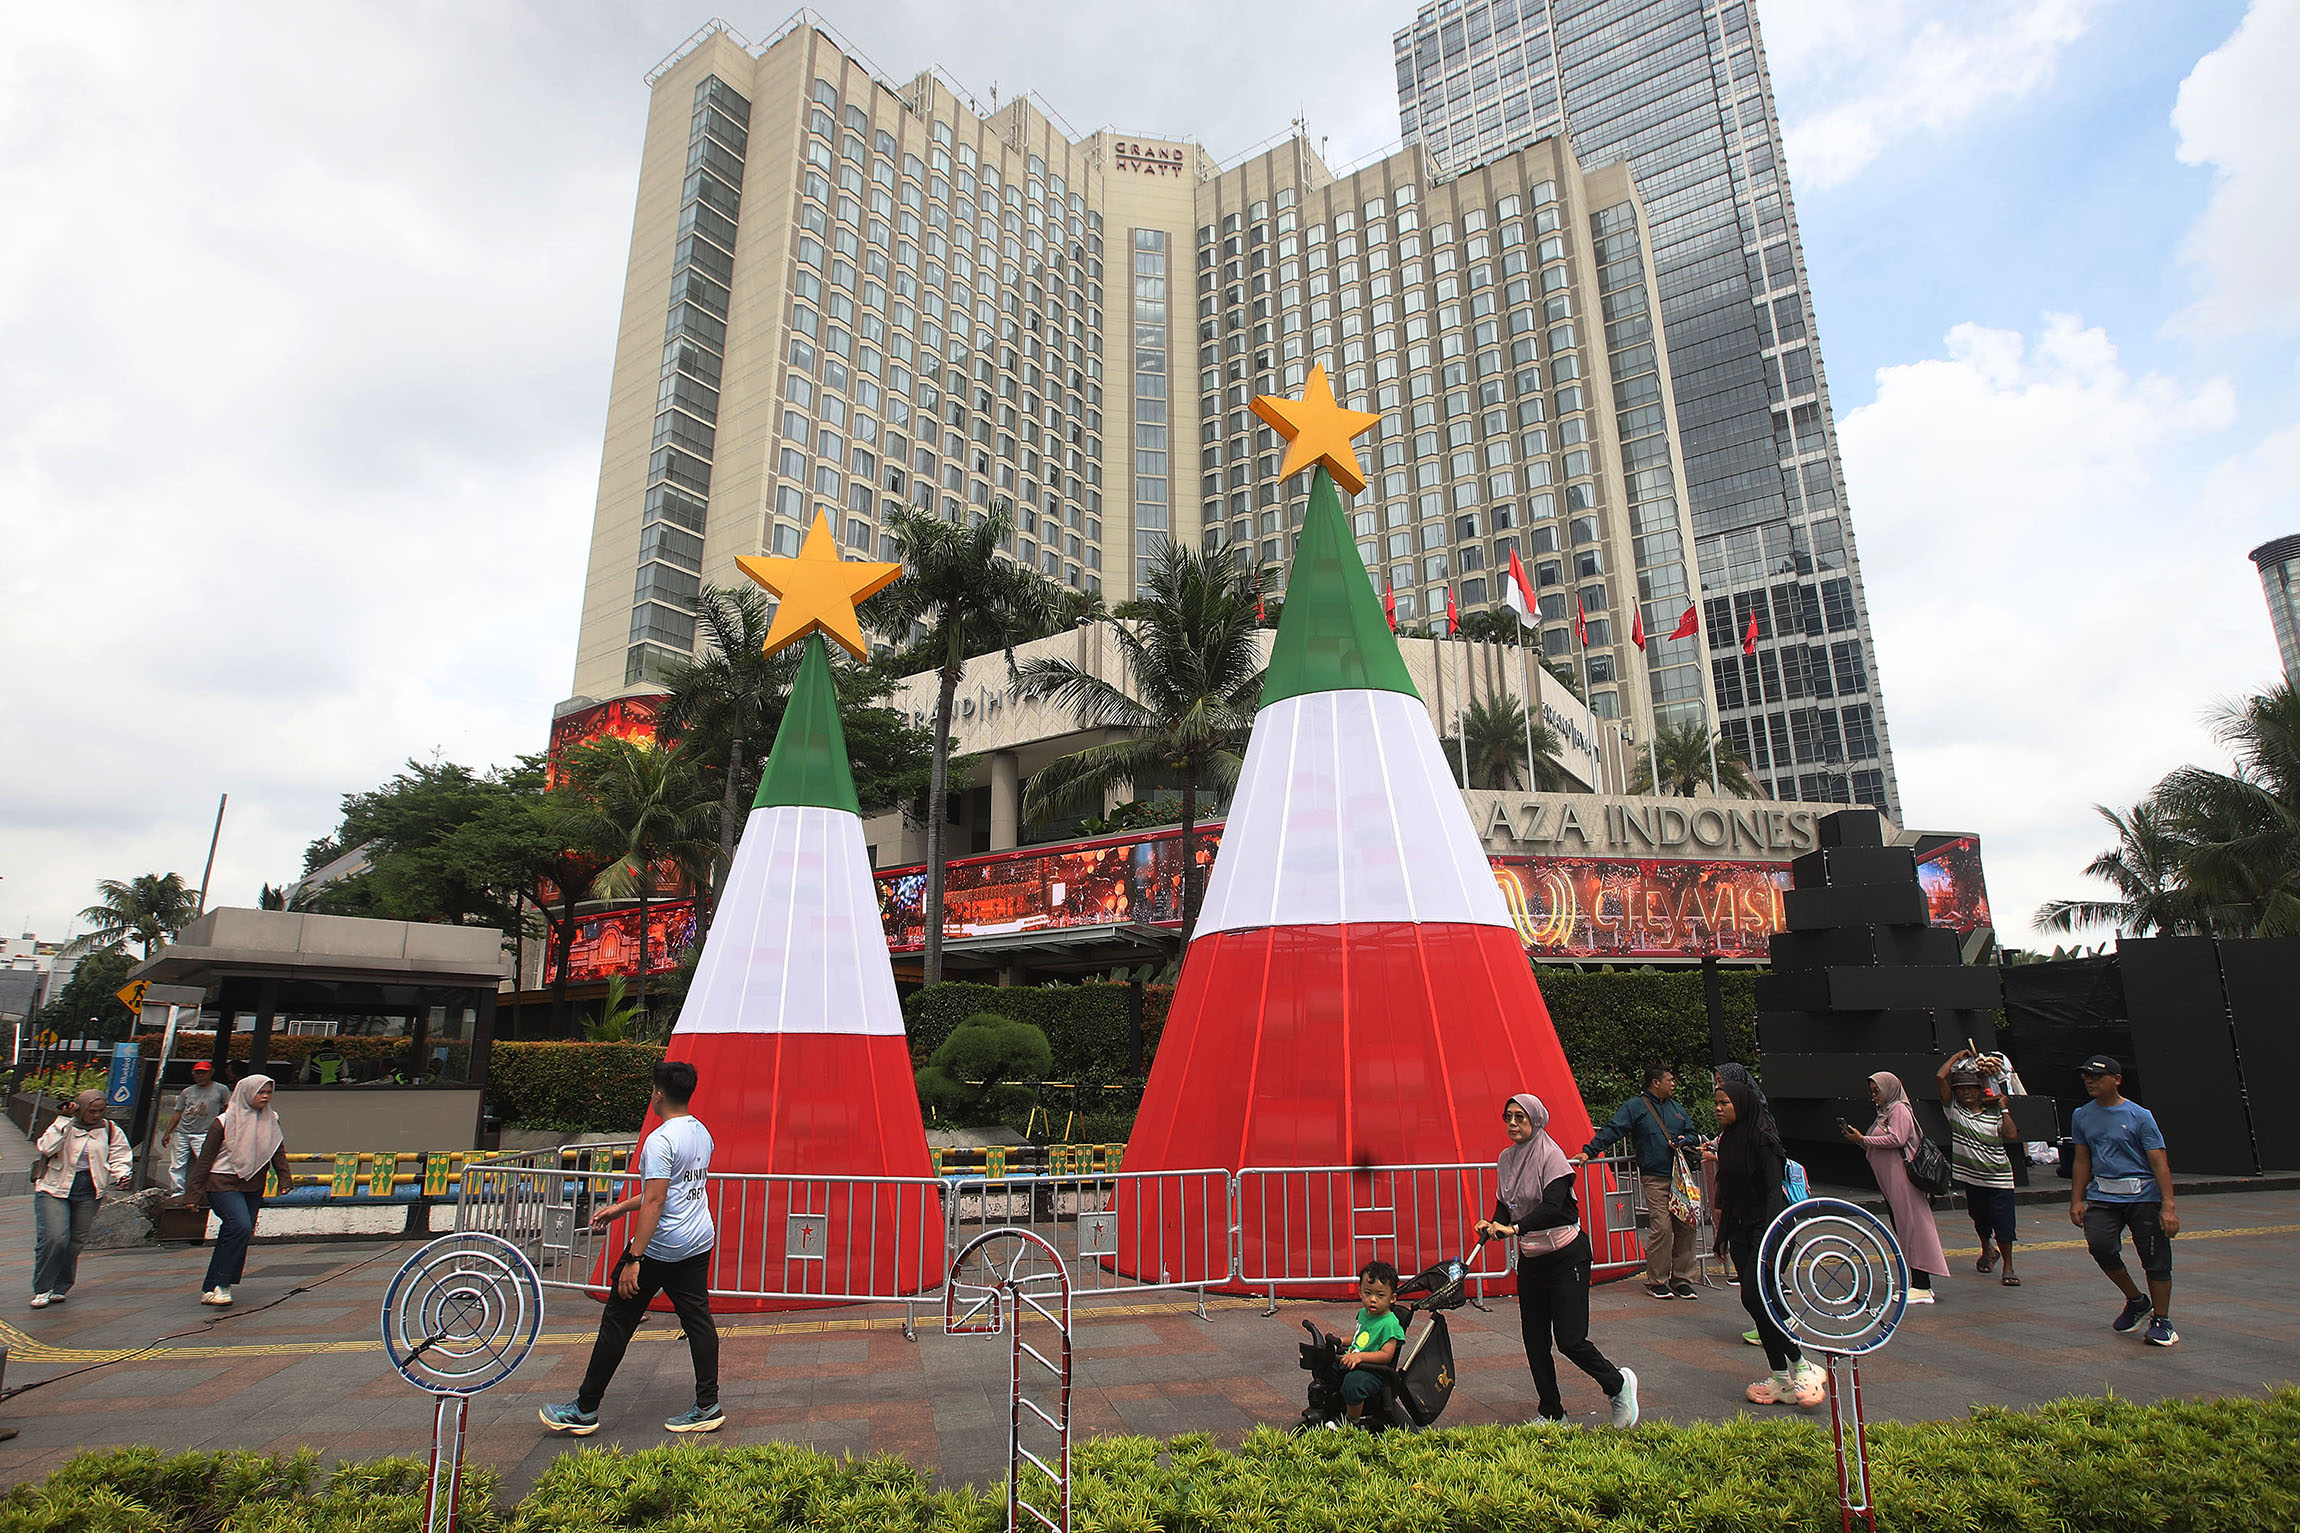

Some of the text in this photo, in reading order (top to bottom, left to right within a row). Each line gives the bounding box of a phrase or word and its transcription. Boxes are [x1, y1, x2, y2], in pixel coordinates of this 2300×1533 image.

[1115, 142, 1184, 160] GRAND
[1116, 159, 1182, 177] HYATT
[1484, 800, 1820, 849] AZA INDONES
